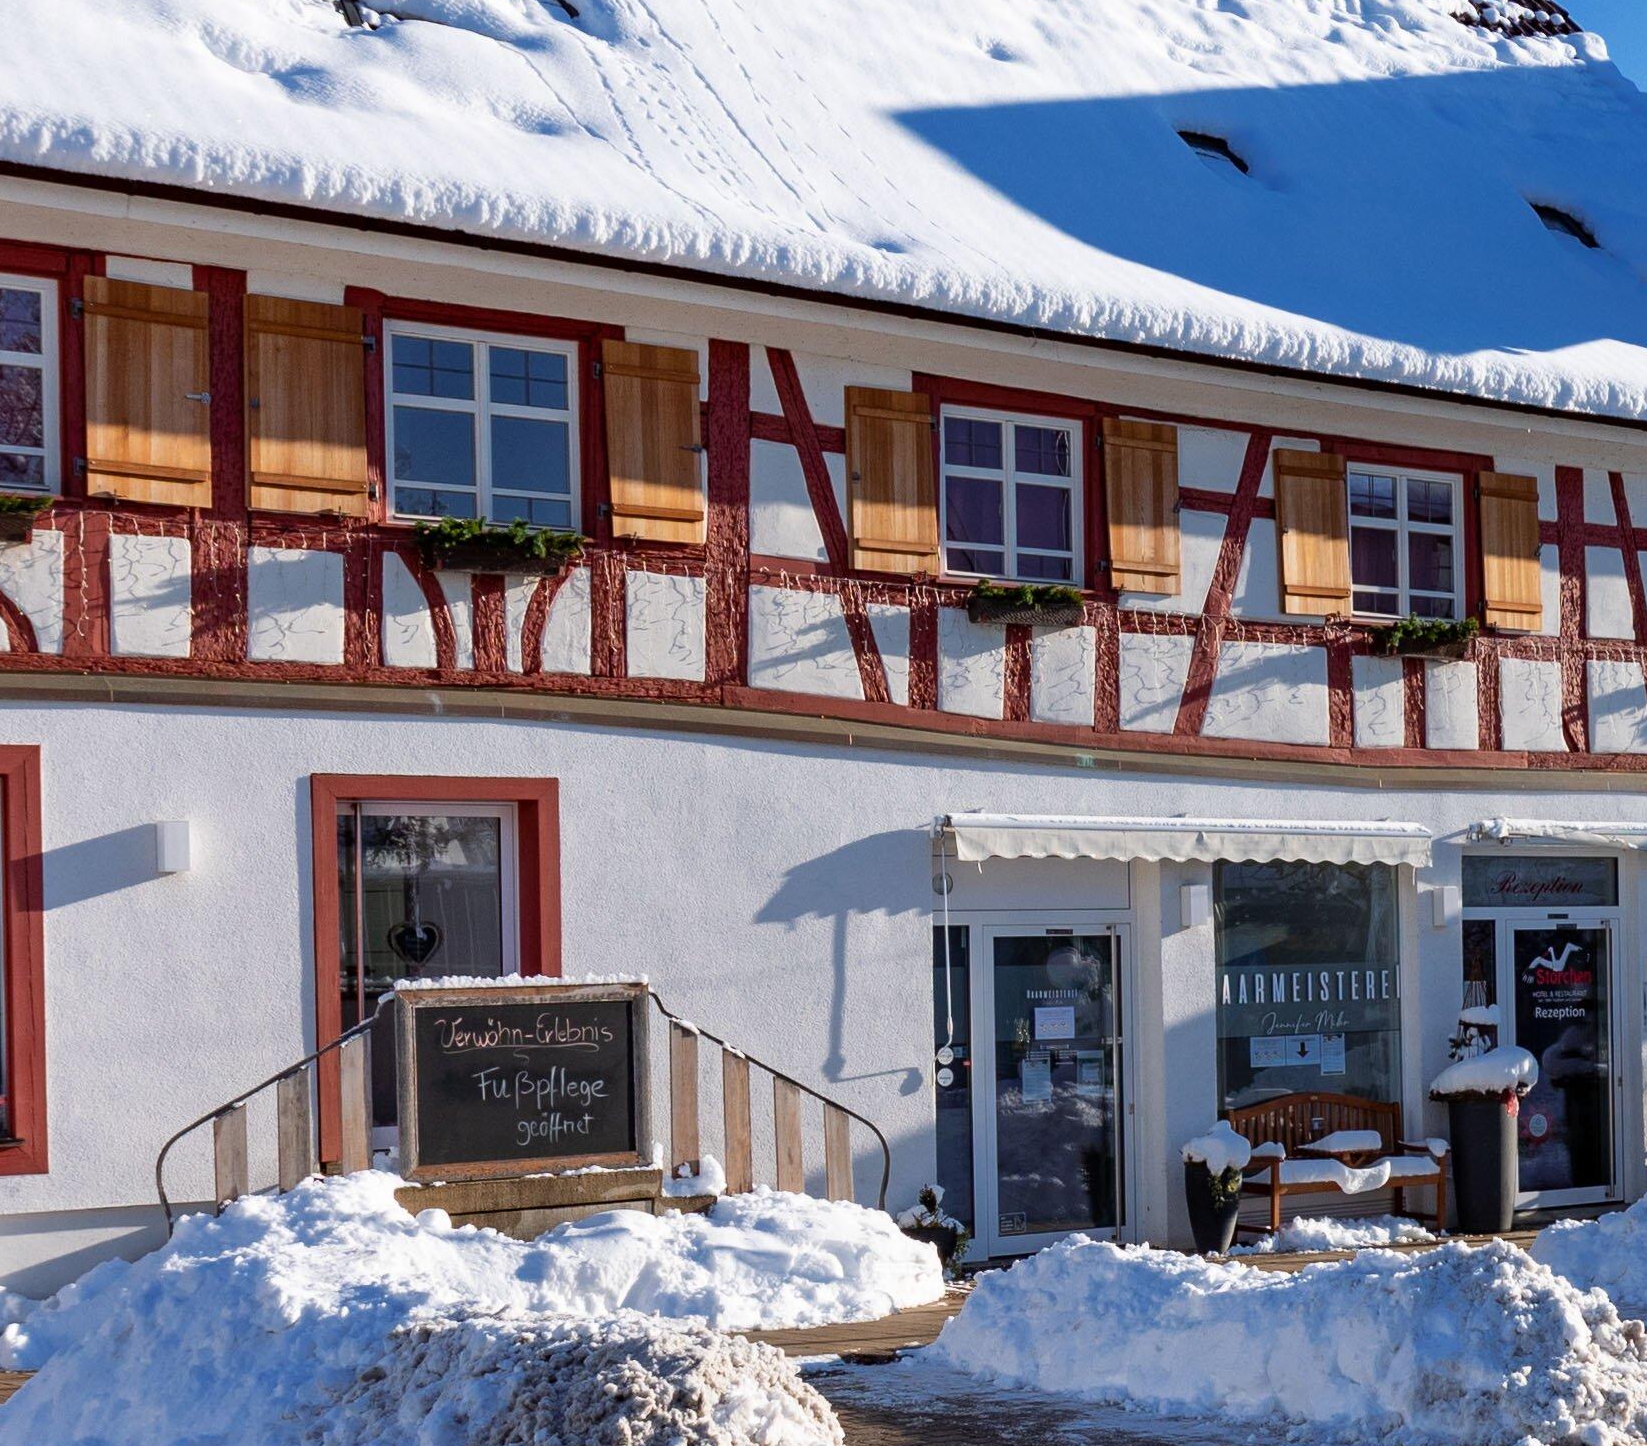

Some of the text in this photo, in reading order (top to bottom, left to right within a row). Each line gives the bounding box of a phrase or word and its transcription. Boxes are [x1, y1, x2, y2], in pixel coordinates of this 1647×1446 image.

[1491, 870, 1584, 902] Rezeption
[1222, 964, 1401, 1005] AARMEISTEREI
[1536, 968, 1592, 985] Storchen
[434, 1012, 614, 1048] Verwöhn-Erlebnis
[1535, 1006, 1586, 1021] Rezeption
[470, 1066, 609, 1110] Fußpflege
[516, 1112, 595, 1146] geöffnet
